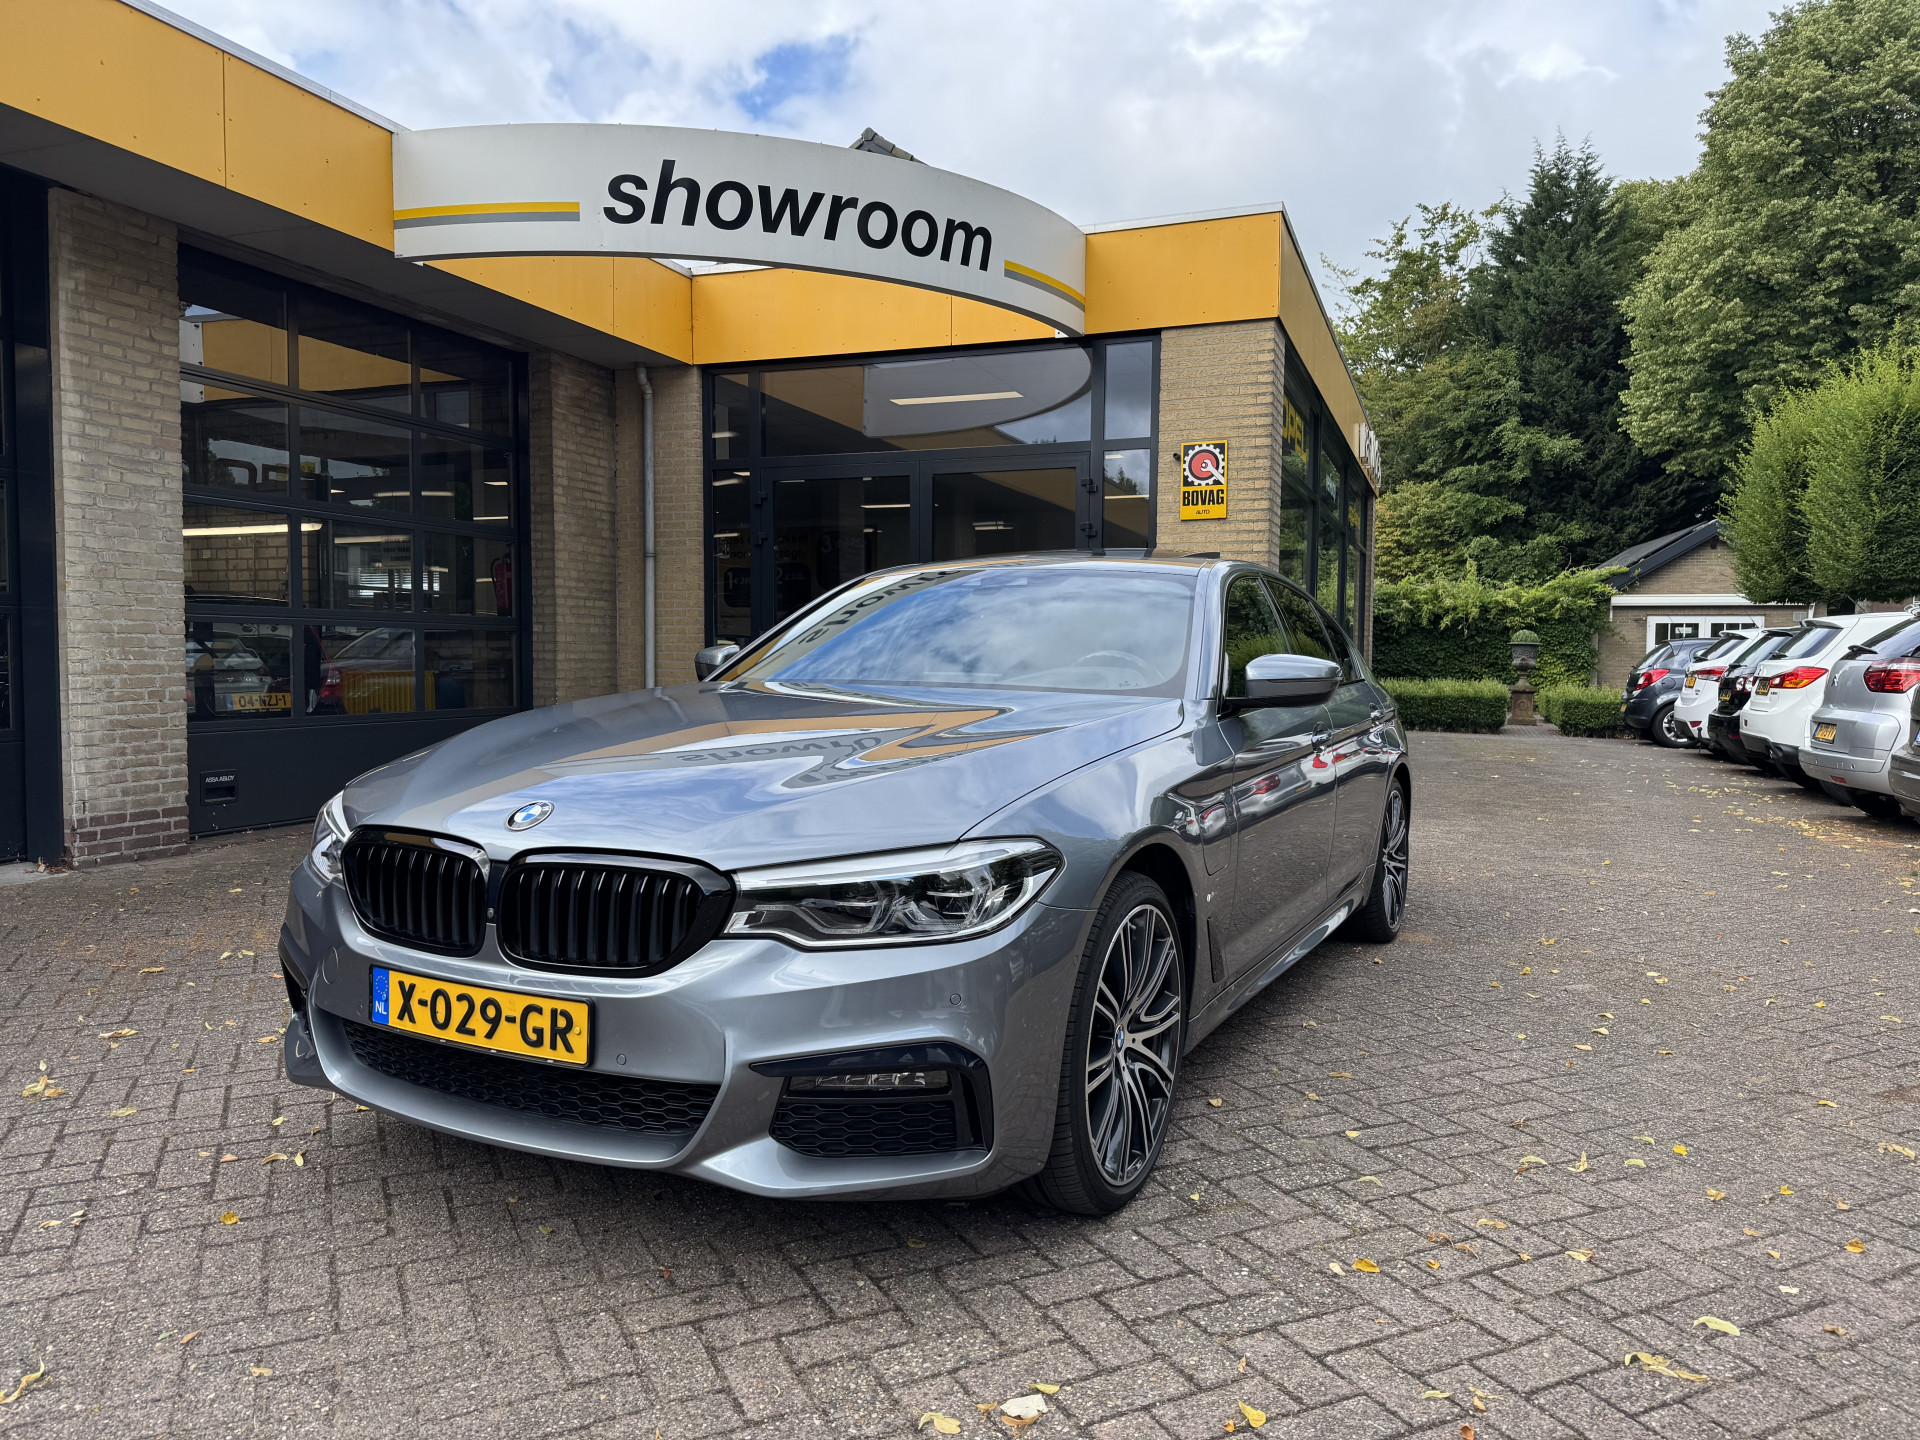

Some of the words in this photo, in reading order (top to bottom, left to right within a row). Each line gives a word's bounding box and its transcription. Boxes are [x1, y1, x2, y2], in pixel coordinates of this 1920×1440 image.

[603, 159, 993, 272] showroom
[1182, 488, 1225, 507] BOVAG
[238, 694, 287, 708] 04-NZJ-1
[375, 1000, 388, 1015] NL
[396, 980, 575, 1054] X-029-GR
